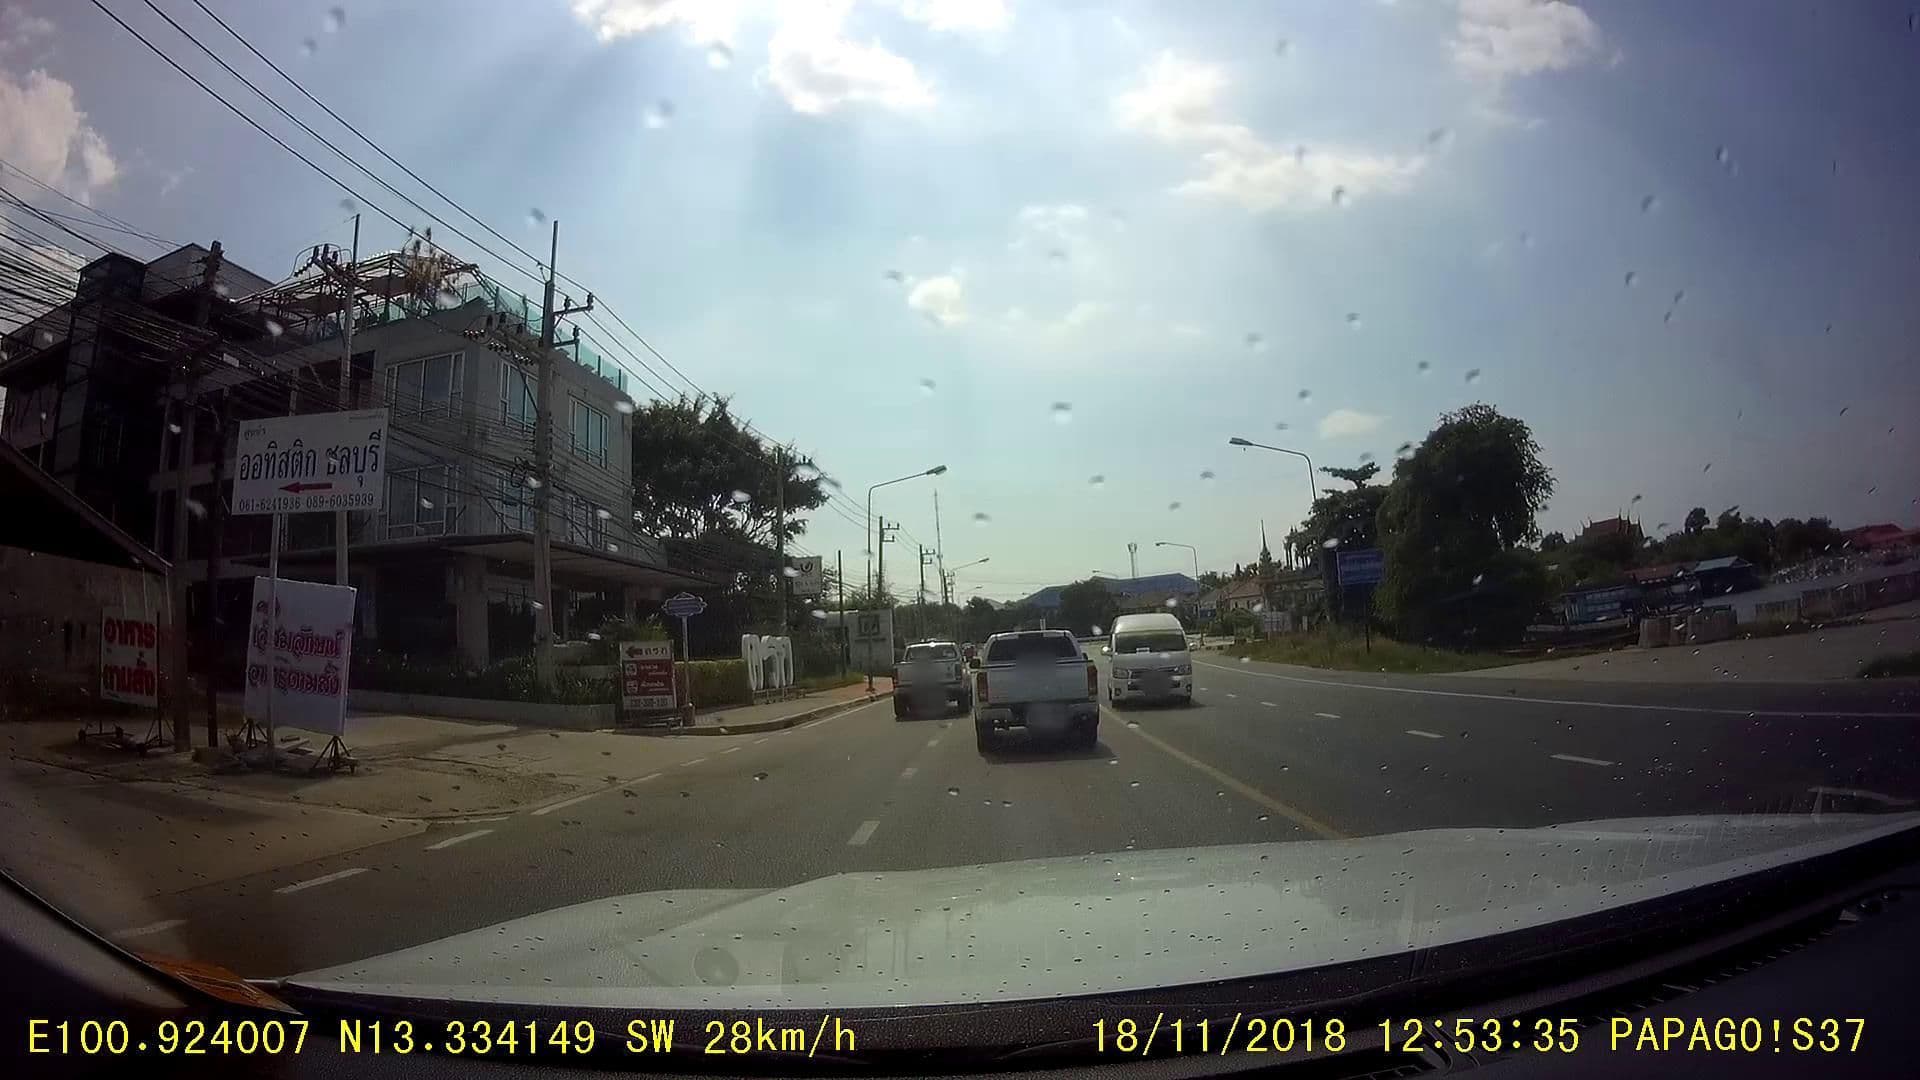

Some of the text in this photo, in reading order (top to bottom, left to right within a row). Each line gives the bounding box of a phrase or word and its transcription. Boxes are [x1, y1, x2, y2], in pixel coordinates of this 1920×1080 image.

[240, 428, 383, 488] ออทิสติก ชลบุรี
[104, 616, 155, 648] อาหาร
[102, 651, 155, 697] ตามสั่ง
